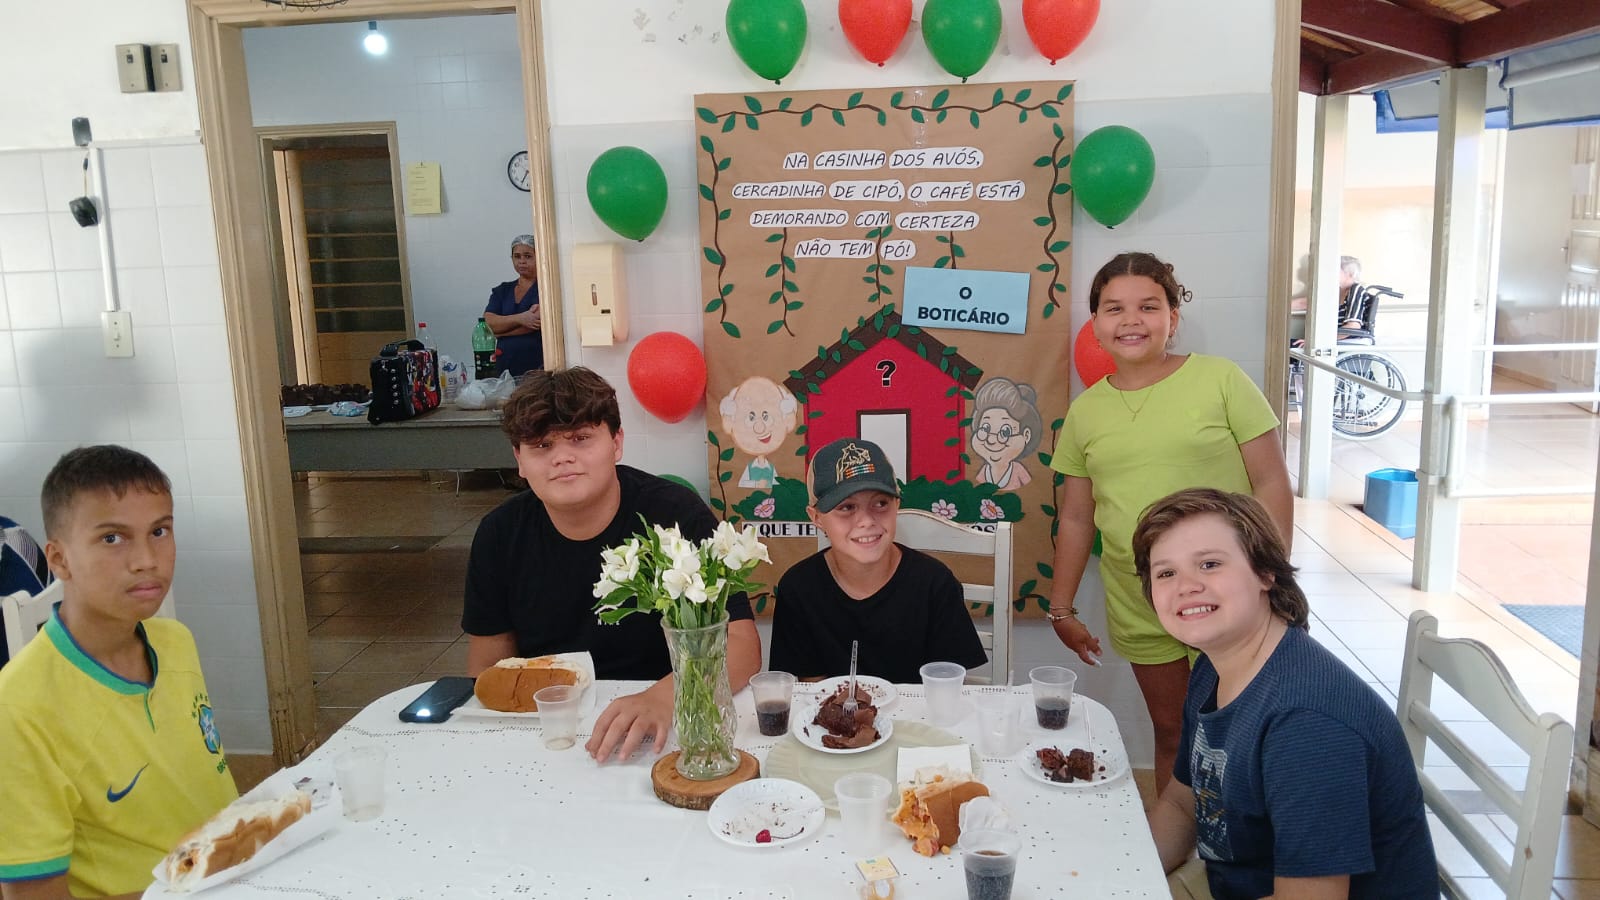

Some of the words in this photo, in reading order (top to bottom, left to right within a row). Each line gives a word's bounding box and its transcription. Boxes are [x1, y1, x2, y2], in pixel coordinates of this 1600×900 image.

[784, 154, 808, 169] NA
[815, 152, 886, 167] CASINHA
[892, 152, 926, 167] DOS
[932, 148, 980, 167] AVÓS,
[733, 183, 825, 197] CERCADINHA
[833, 185, 856, 198] DE
[862, 181, 902, 200] CIPÓ,
[910, 186, 922, 199] O
[930, 182, 972, 199] CAFÉ
[978, 181, 1021, 198] ESTÁ
[752, 212, 847, 225] DEMORANDO
[854, 212, 890, 226] COM
[899, 215, 975, 229] CERTEZA
[796, 239, 831, 256] NÃO
[839, 242, 873, 256] TEM
[883, 241, 911, 259] PÓ!
[959, 286, 973, 300] O
[917, 306, 1010, 325] BOTICÁRIO
[876, 359, 897, 388] ?
[760, 523, 792, 538] QUE
